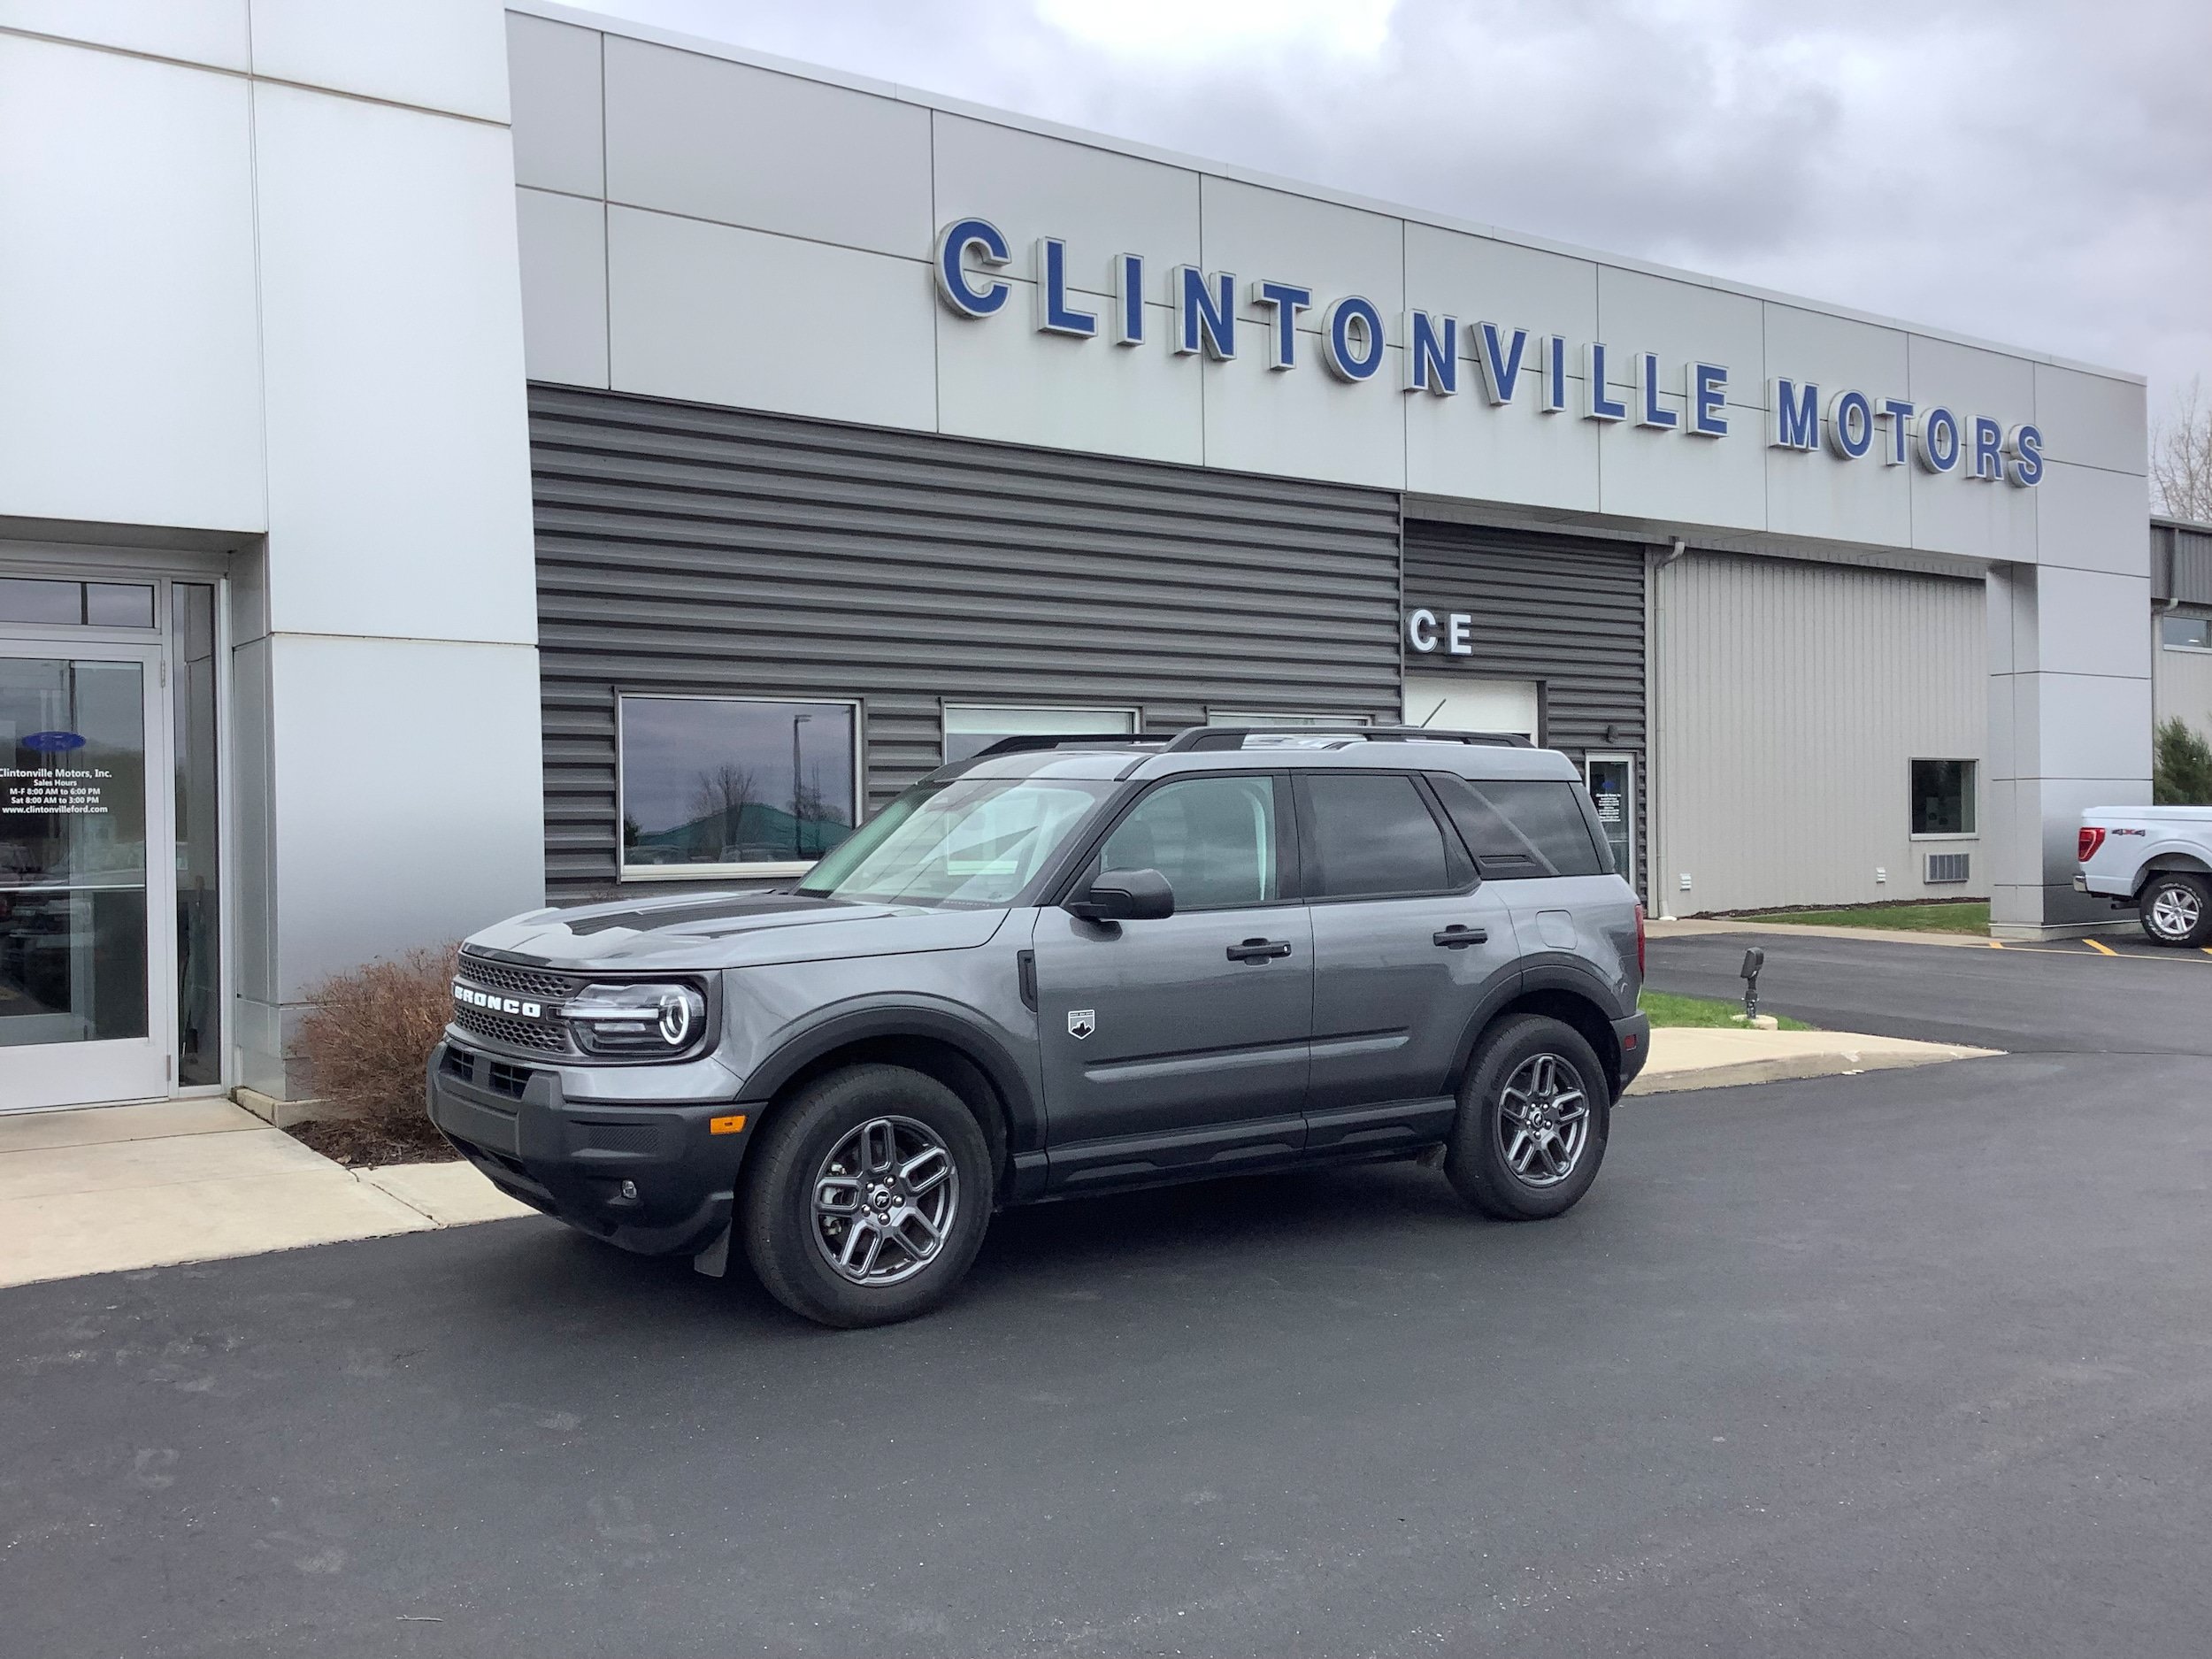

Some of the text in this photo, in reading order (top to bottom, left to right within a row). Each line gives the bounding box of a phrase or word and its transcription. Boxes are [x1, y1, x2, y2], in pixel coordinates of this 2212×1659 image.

[933, 217, 2046, 488] CLINTONVILLE MOTORS
[0, 768, 112, 779] Clintonville Motors, Inc.
[454, 985, 541, 1018] BRONCO
